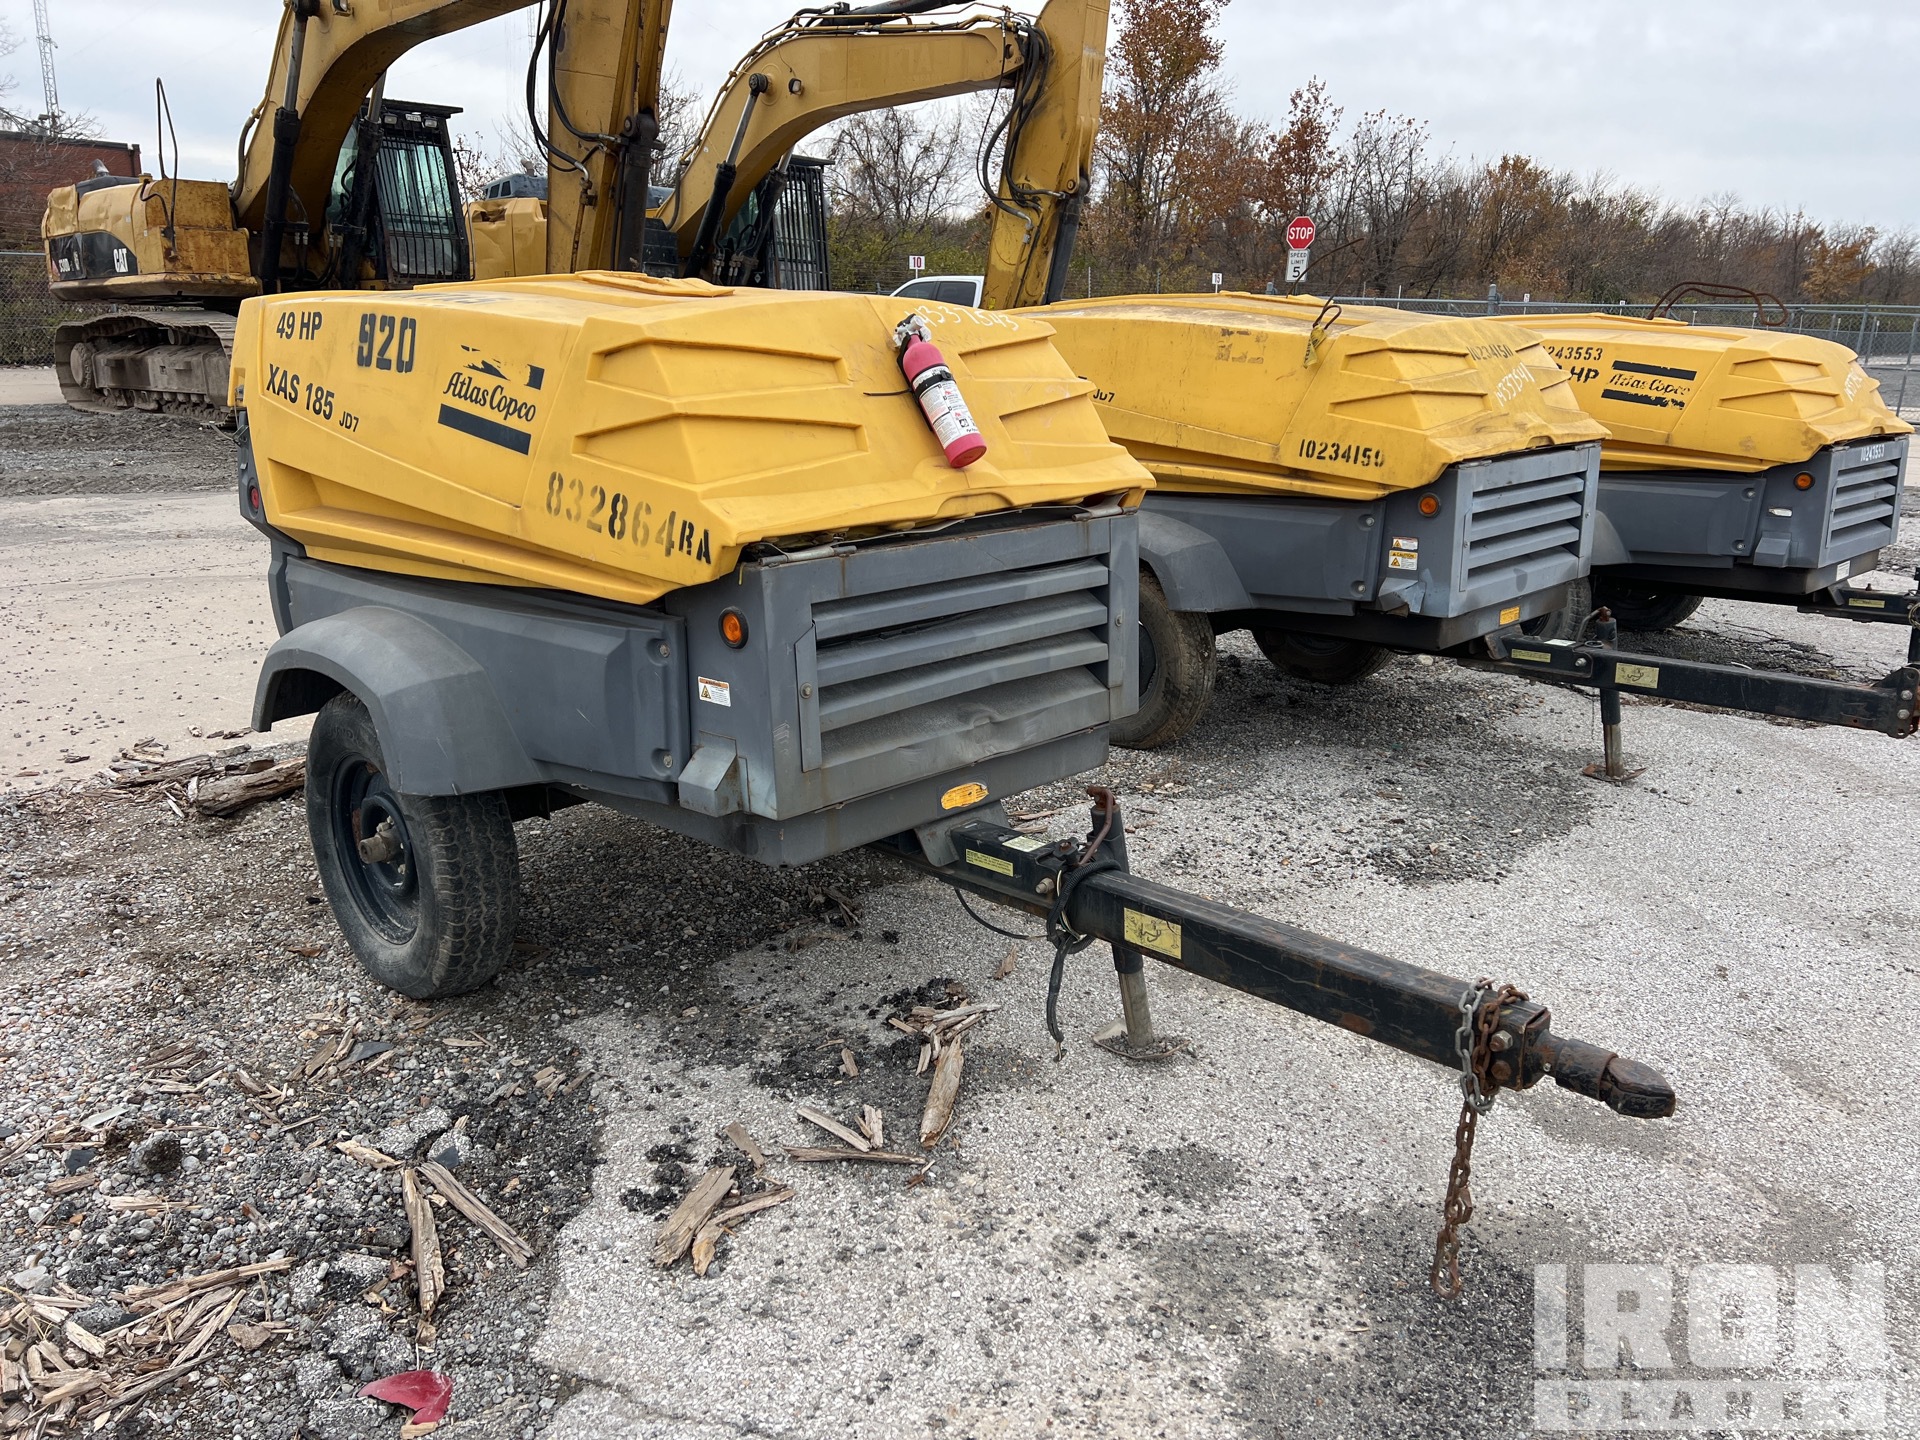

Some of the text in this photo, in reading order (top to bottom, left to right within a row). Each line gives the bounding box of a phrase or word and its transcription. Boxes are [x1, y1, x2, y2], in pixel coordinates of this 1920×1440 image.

[1289, 227, 1313, 240] STOP
[113, 248, 128, 272] CAT
[912, 256, 922, 268] 10
[1292, 266, 1301, 278] 5
[276, 311, 323, 341] 49 HP
[356, 313, 417, 374] 920
[1543, 345, 1603, 361] 243553
[1568, 365, 1600, 384] HP
[266, 363, 360, 433] XAS 185 JD7
[443, 371, 537, 422] Atlas Copco
